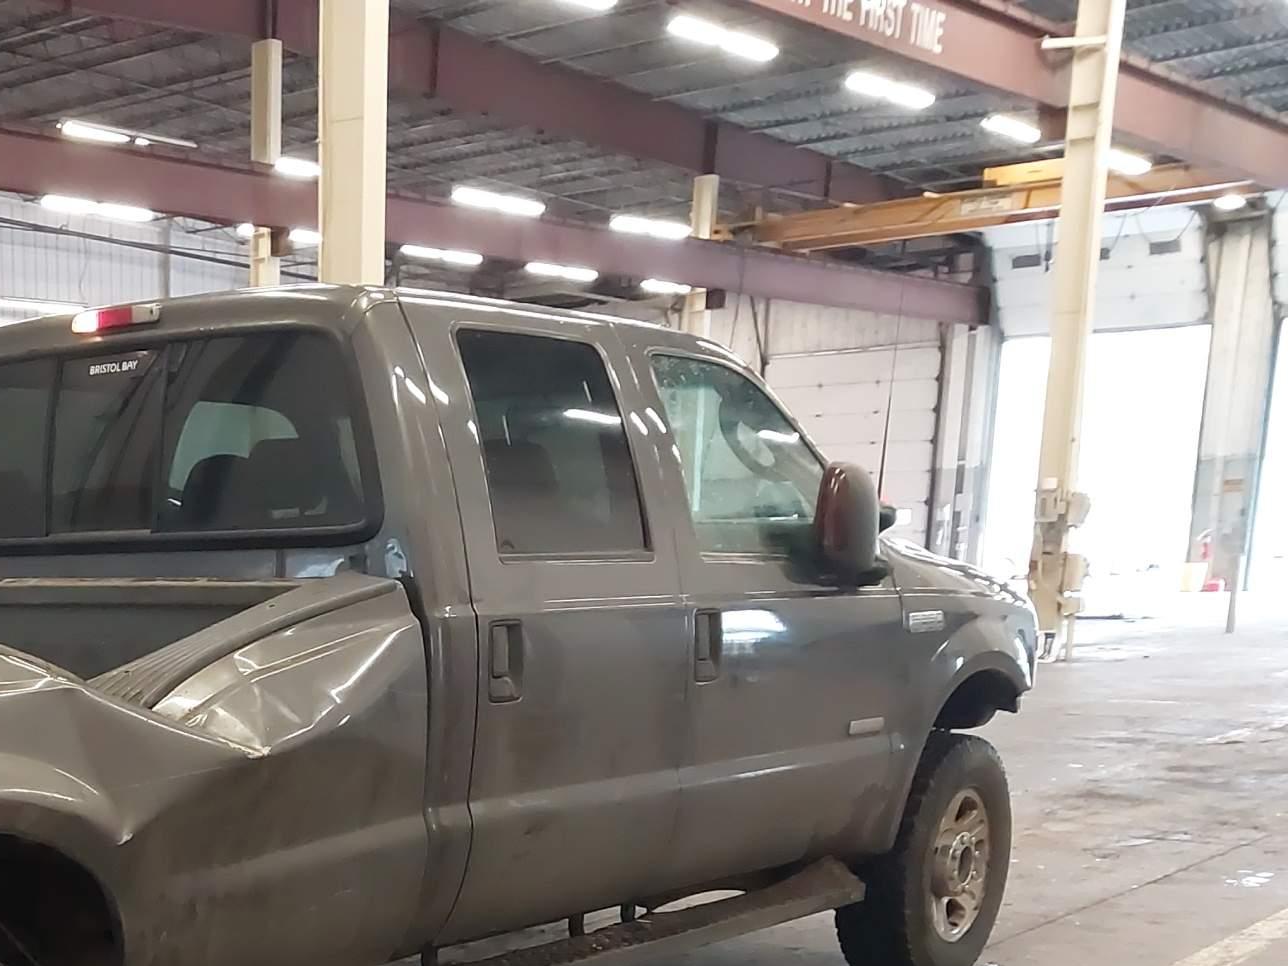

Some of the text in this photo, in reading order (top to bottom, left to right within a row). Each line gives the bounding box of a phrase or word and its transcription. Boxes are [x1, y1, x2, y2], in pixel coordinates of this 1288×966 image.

[859, 0, 907, 39] FIRST
[910, 3, 946, 54] TIME
[89, 360, 138, 376] BRISTOL BAY
